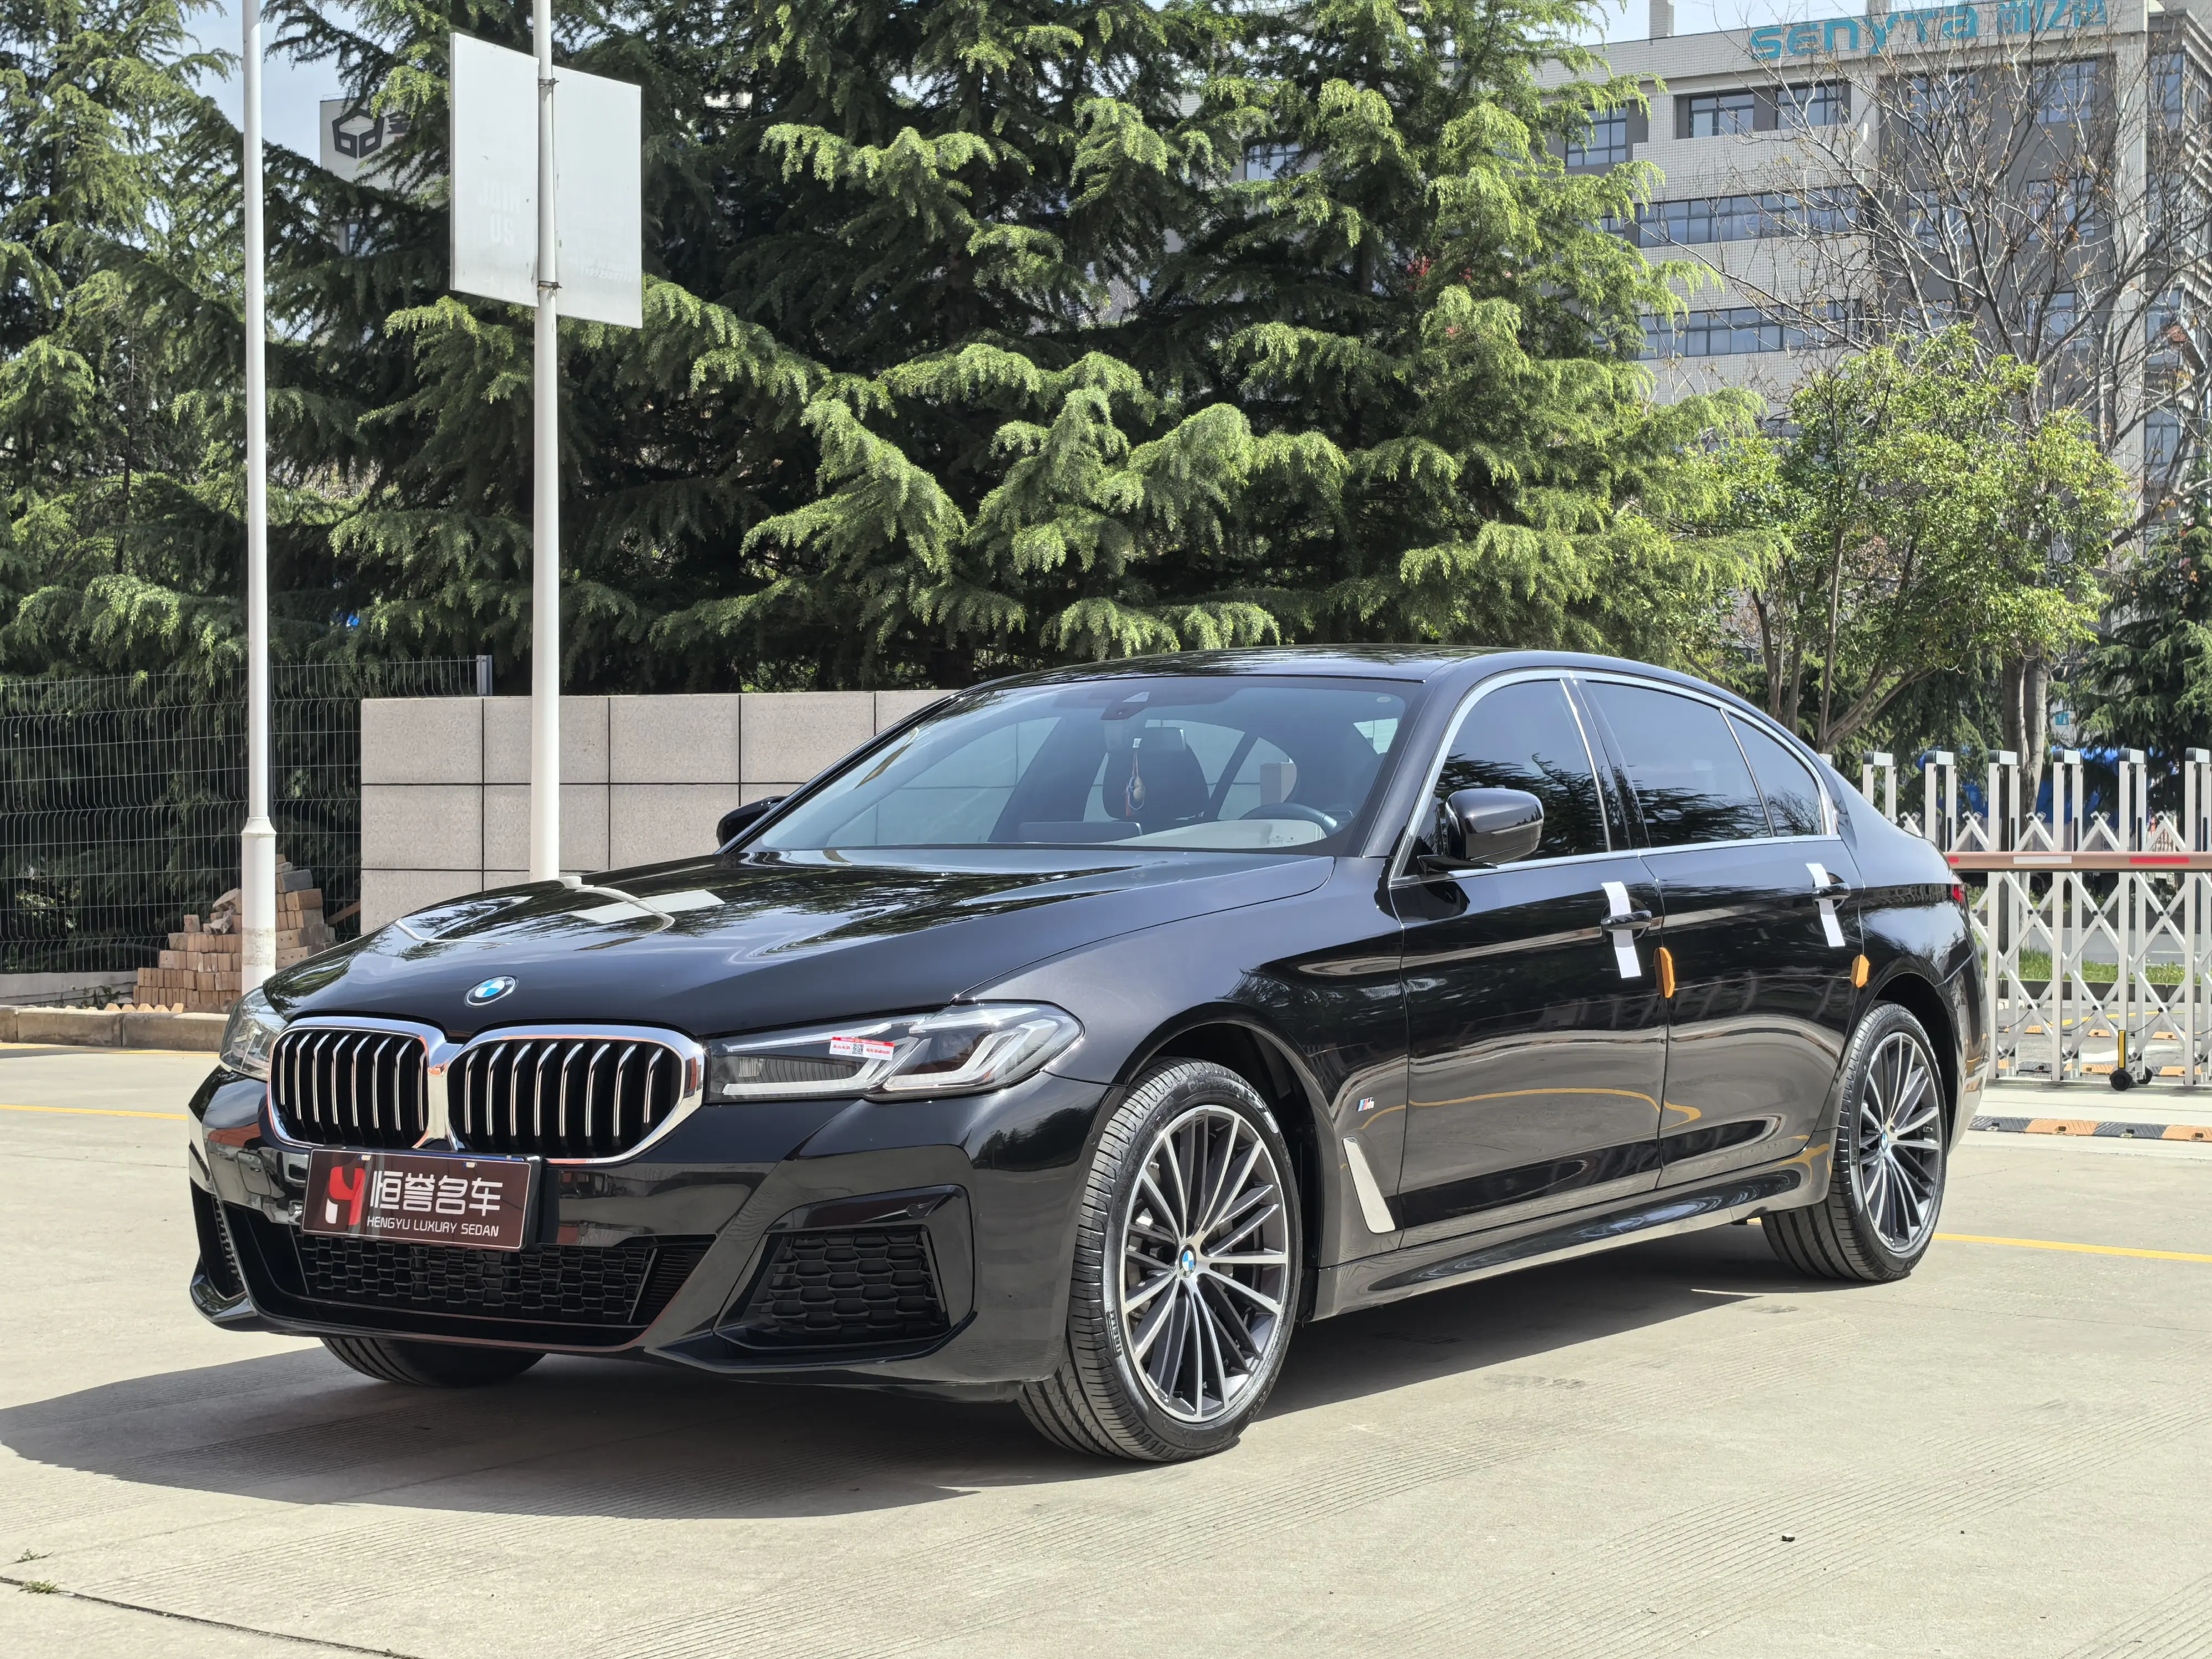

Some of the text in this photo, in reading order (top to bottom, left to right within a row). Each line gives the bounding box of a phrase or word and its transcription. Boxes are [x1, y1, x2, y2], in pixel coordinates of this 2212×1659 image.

[478, 178, 521, 215] JOIN
[490, 213, 515, 246] US
[370, 1170, 503, 1216] 恒誉名车
[367, 1215, 499, 1237] HENGYU LUXURY SEDAN
